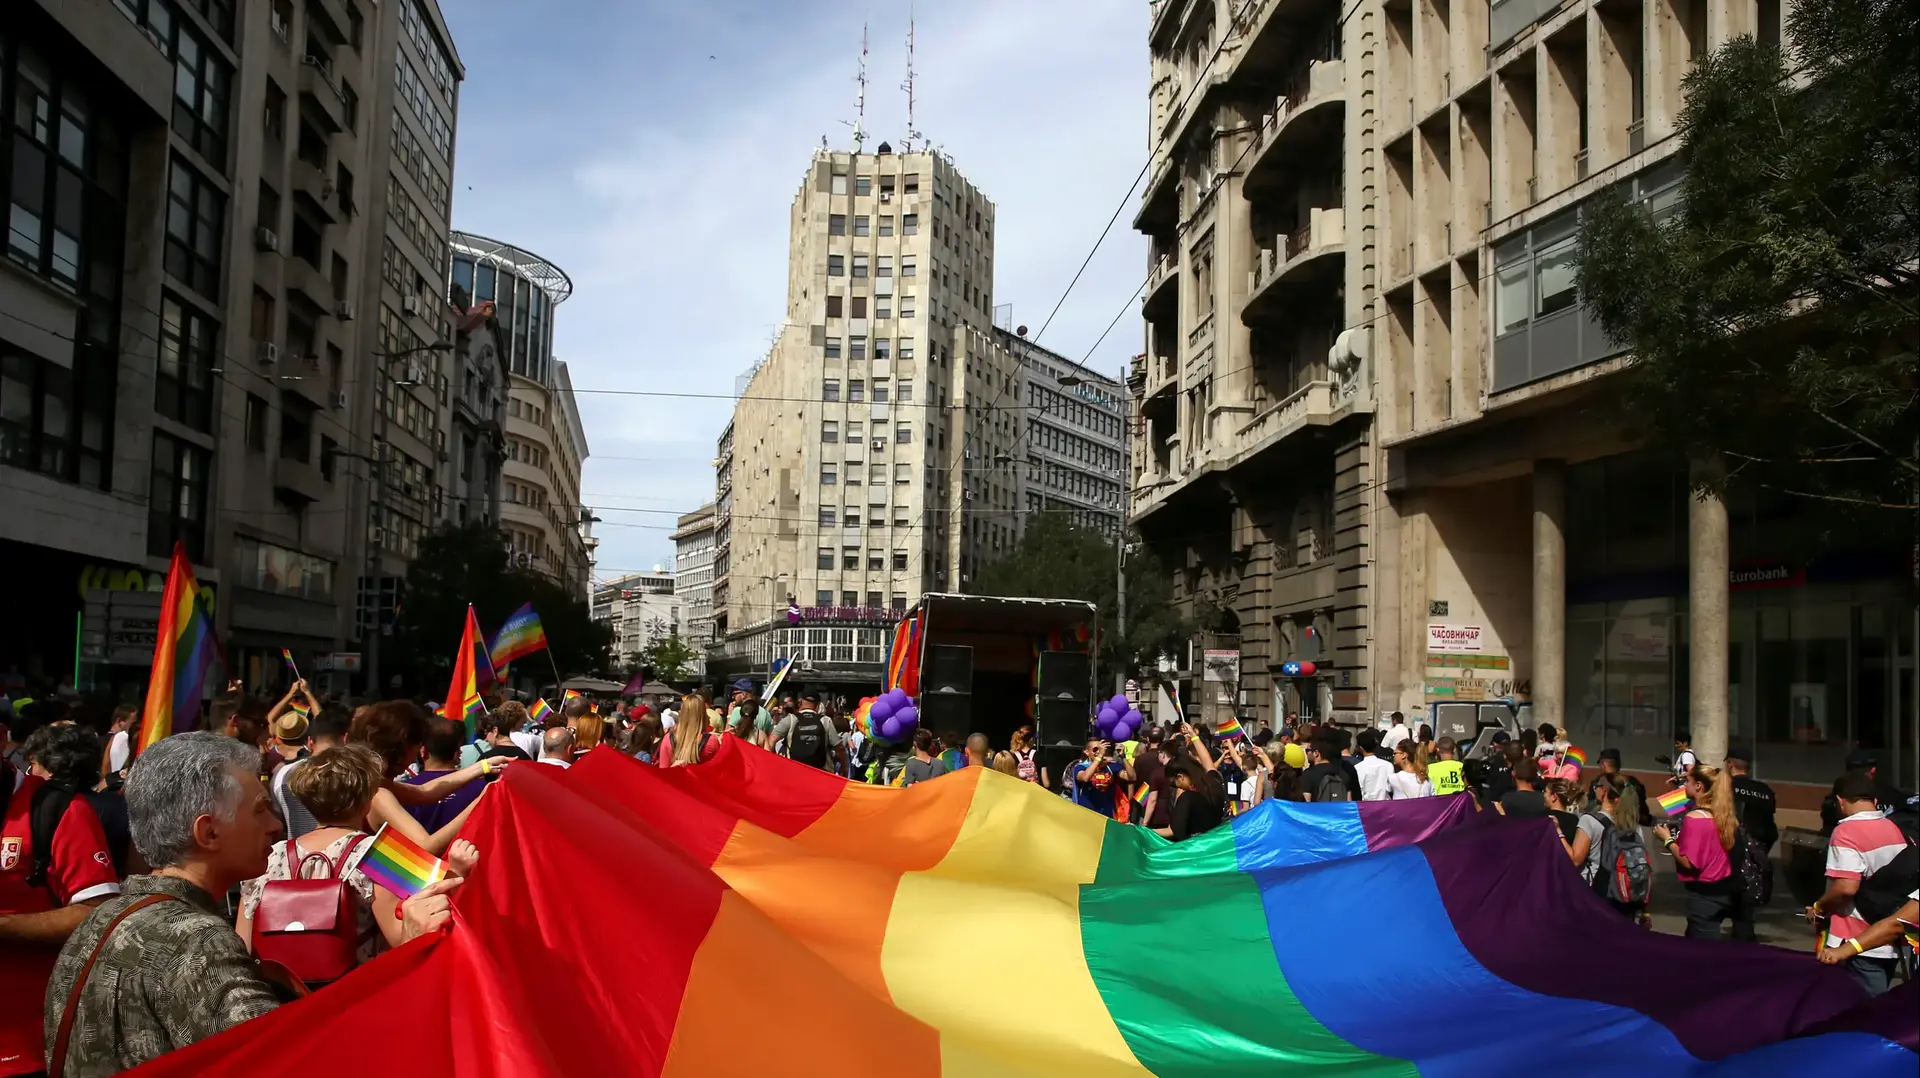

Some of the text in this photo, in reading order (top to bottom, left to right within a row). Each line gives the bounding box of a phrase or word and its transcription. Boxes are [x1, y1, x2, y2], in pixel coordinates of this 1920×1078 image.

[1730, 566, 1789, 582] Eurobank
[1432, 630, 1479, 640] ЧАСОВНИЧАР
[1440, 771, 1459, 784] KGB
